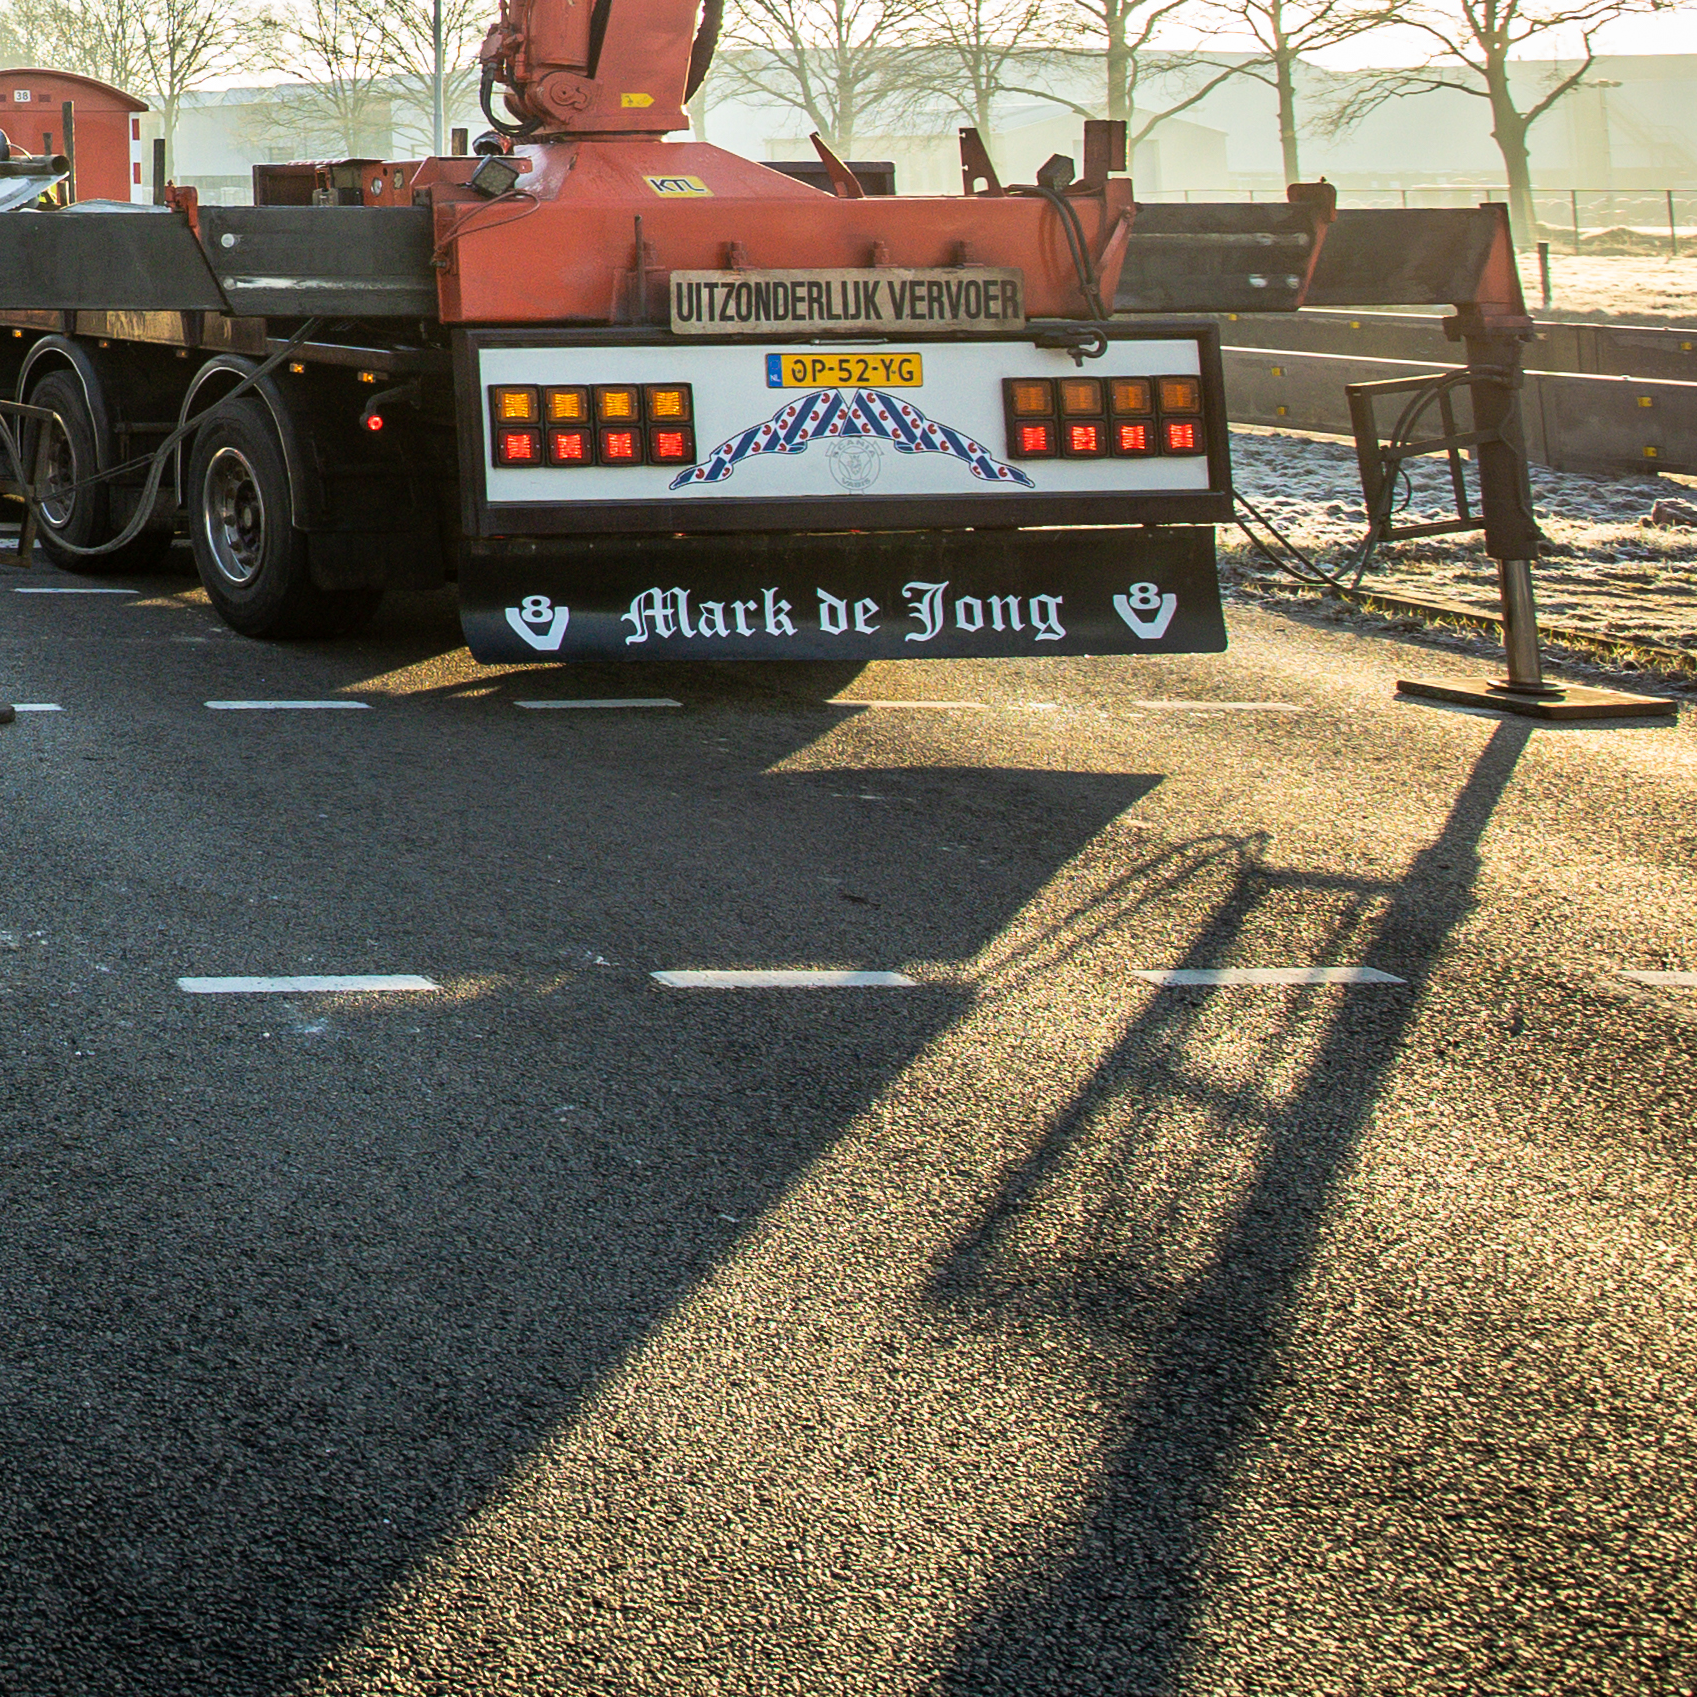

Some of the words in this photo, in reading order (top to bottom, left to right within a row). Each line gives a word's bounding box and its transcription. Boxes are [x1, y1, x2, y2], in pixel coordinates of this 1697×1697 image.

[16, 91, 29, 101] 38
[675, 280, 884, 322] UITZONDERLIJK
[887, 279, 1021, 320] VERVOER
[620, 586, 799, 645] Mark
[816, 587, 881, 635] de
[901, 580, 1067, 642] Jong
